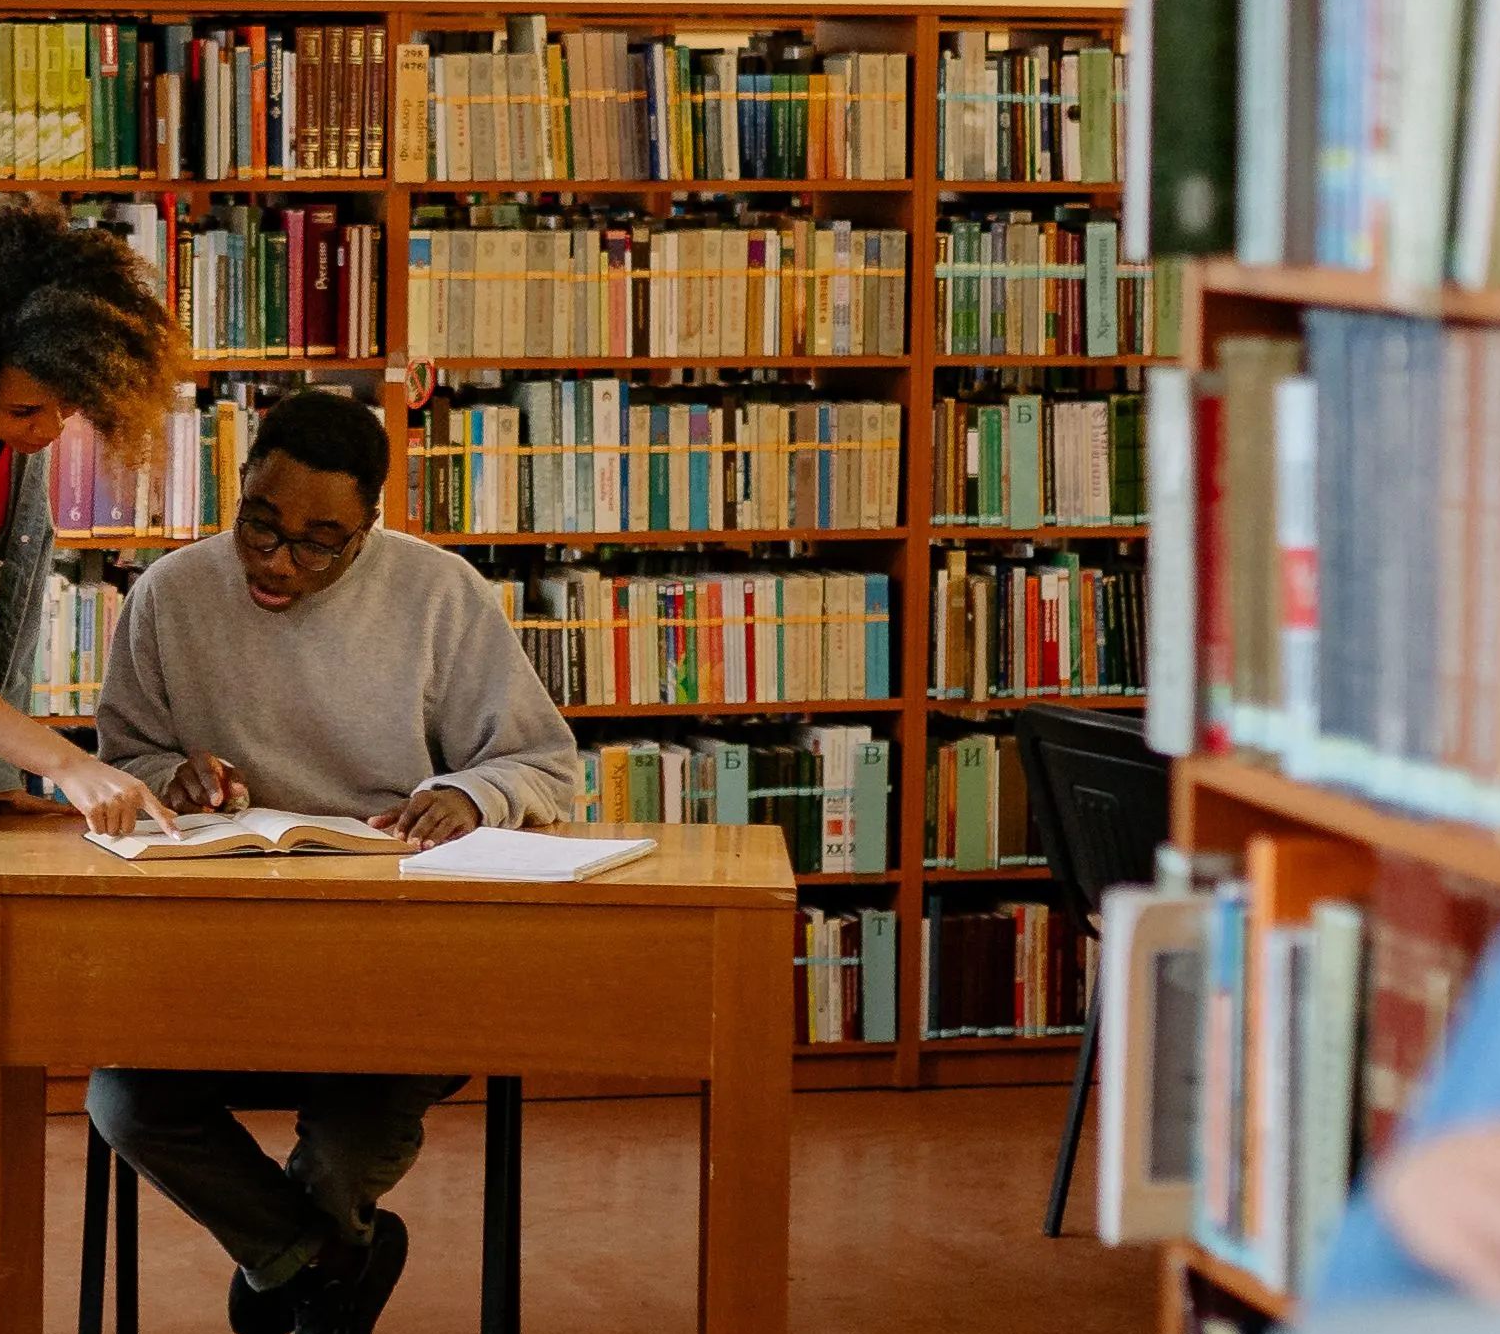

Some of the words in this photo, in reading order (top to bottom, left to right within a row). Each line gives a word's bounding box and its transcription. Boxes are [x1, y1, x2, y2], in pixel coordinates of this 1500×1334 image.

[399, 99, 412, 162] Фольклор
[1097, 238, 1111, 340] Хрестоматия
[1016, 405, 1033, 424] Б
[70, 507, 81, 521] 6
[111, 506, 122, 520] 6
[724, 751, 742, 770] Б
[864, 746, 881, 765] В
[963, 747, 986, 767] И
[871, 916, 889, 937] Т
